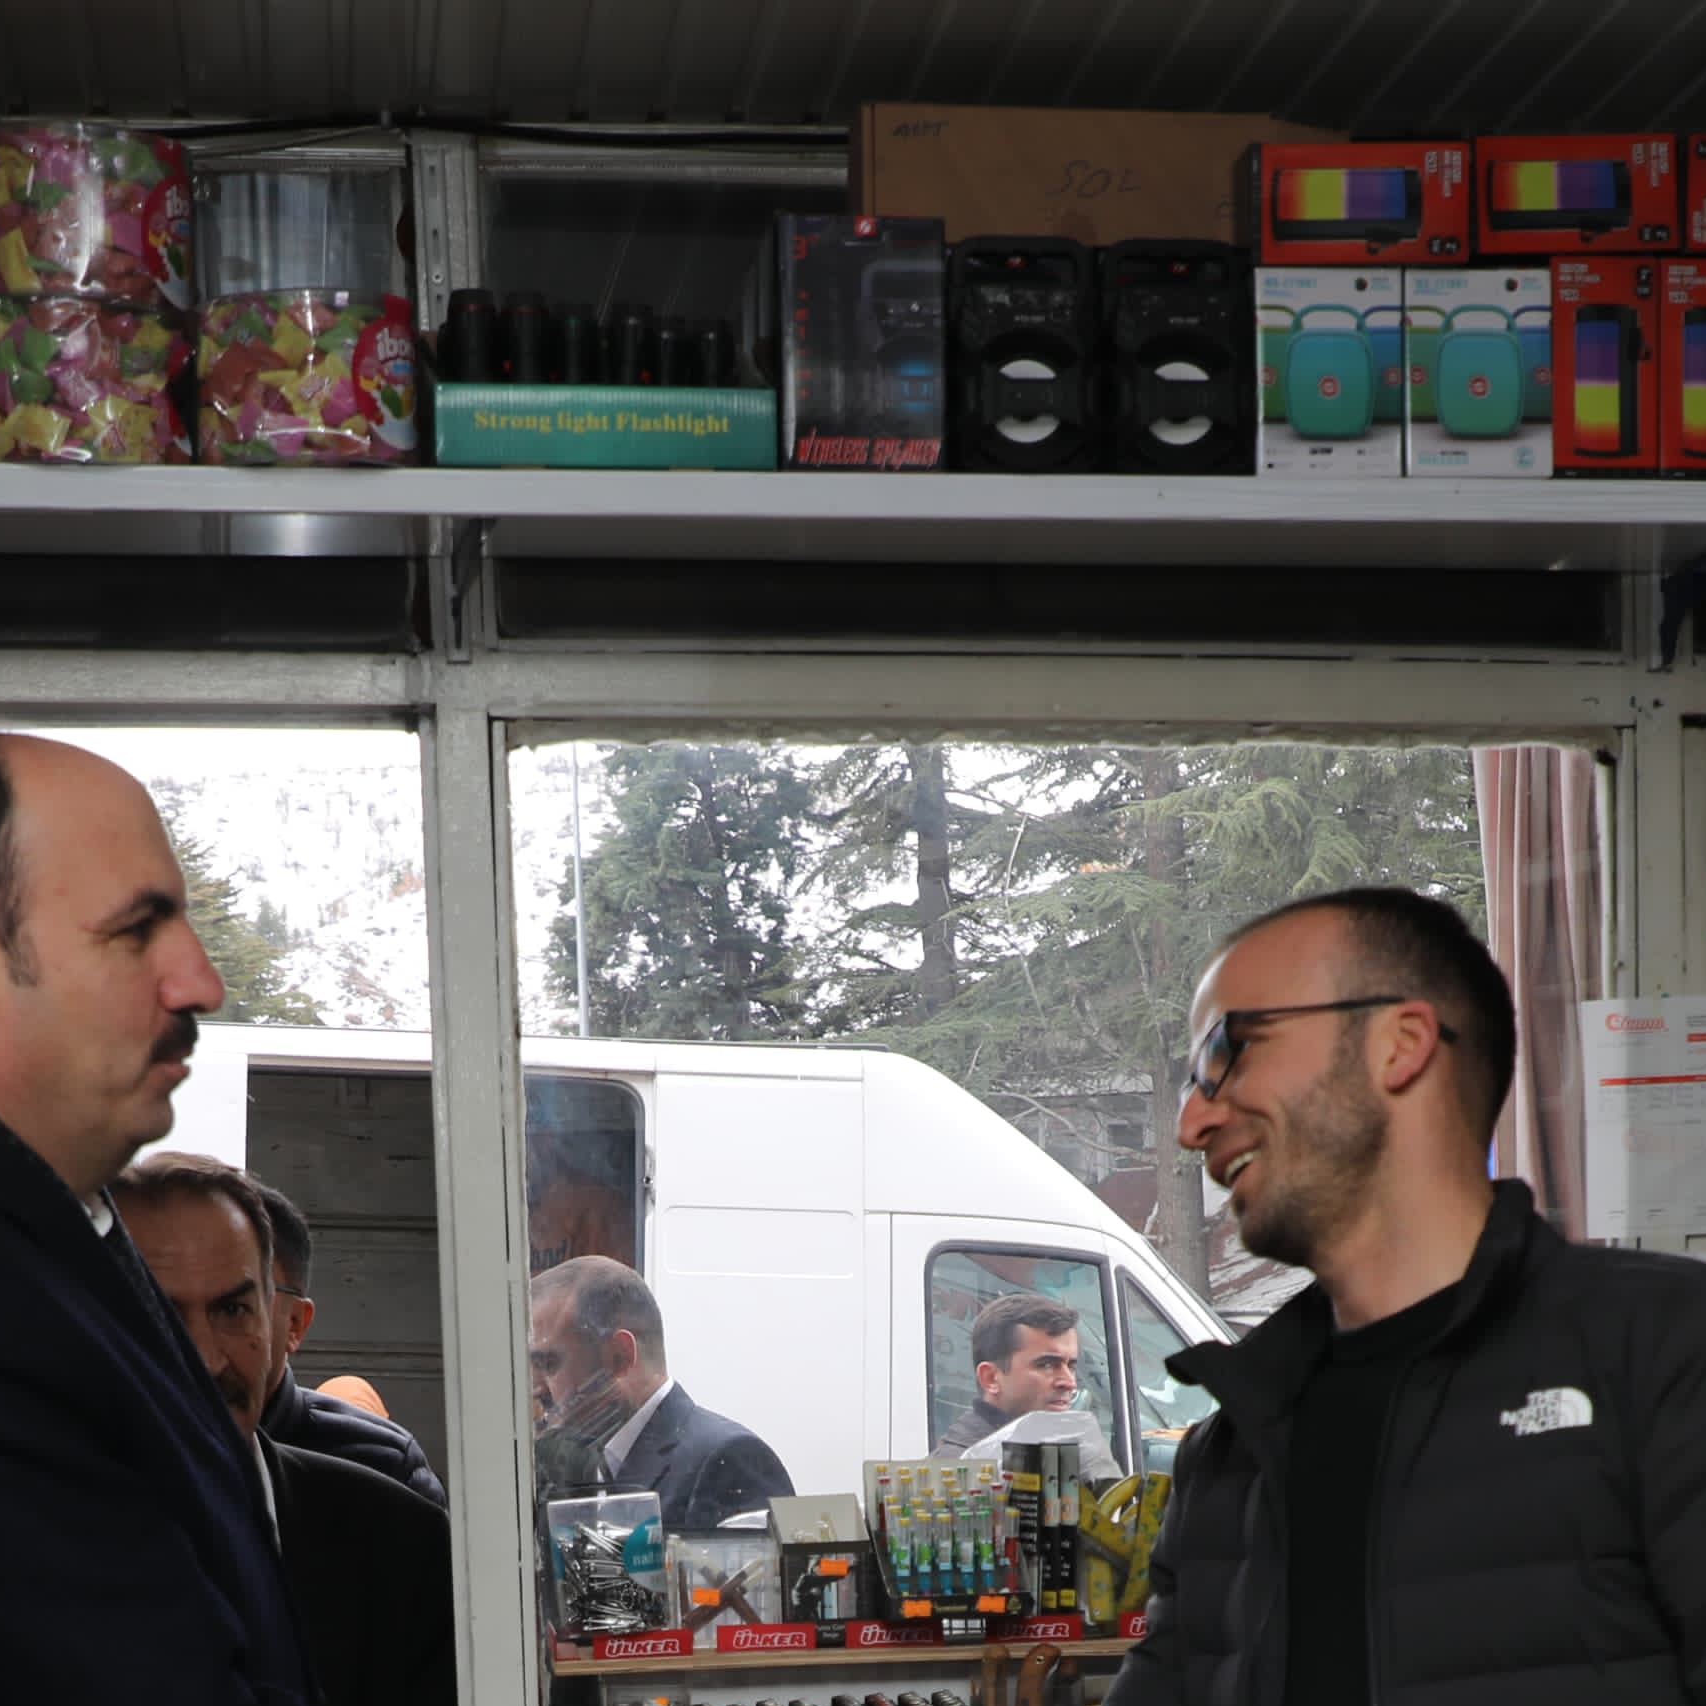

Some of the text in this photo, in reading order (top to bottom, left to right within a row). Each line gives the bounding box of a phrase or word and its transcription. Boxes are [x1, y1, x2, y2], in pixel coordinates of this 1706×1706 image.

[474, 410, 731, 437] Strong light Flashlight
[733, 1628, 807, 1649] ÜLKER
[996, 1618, 1071, 1642] ÜLKER
[604, 1636, 681, 1658] ÜLKER
